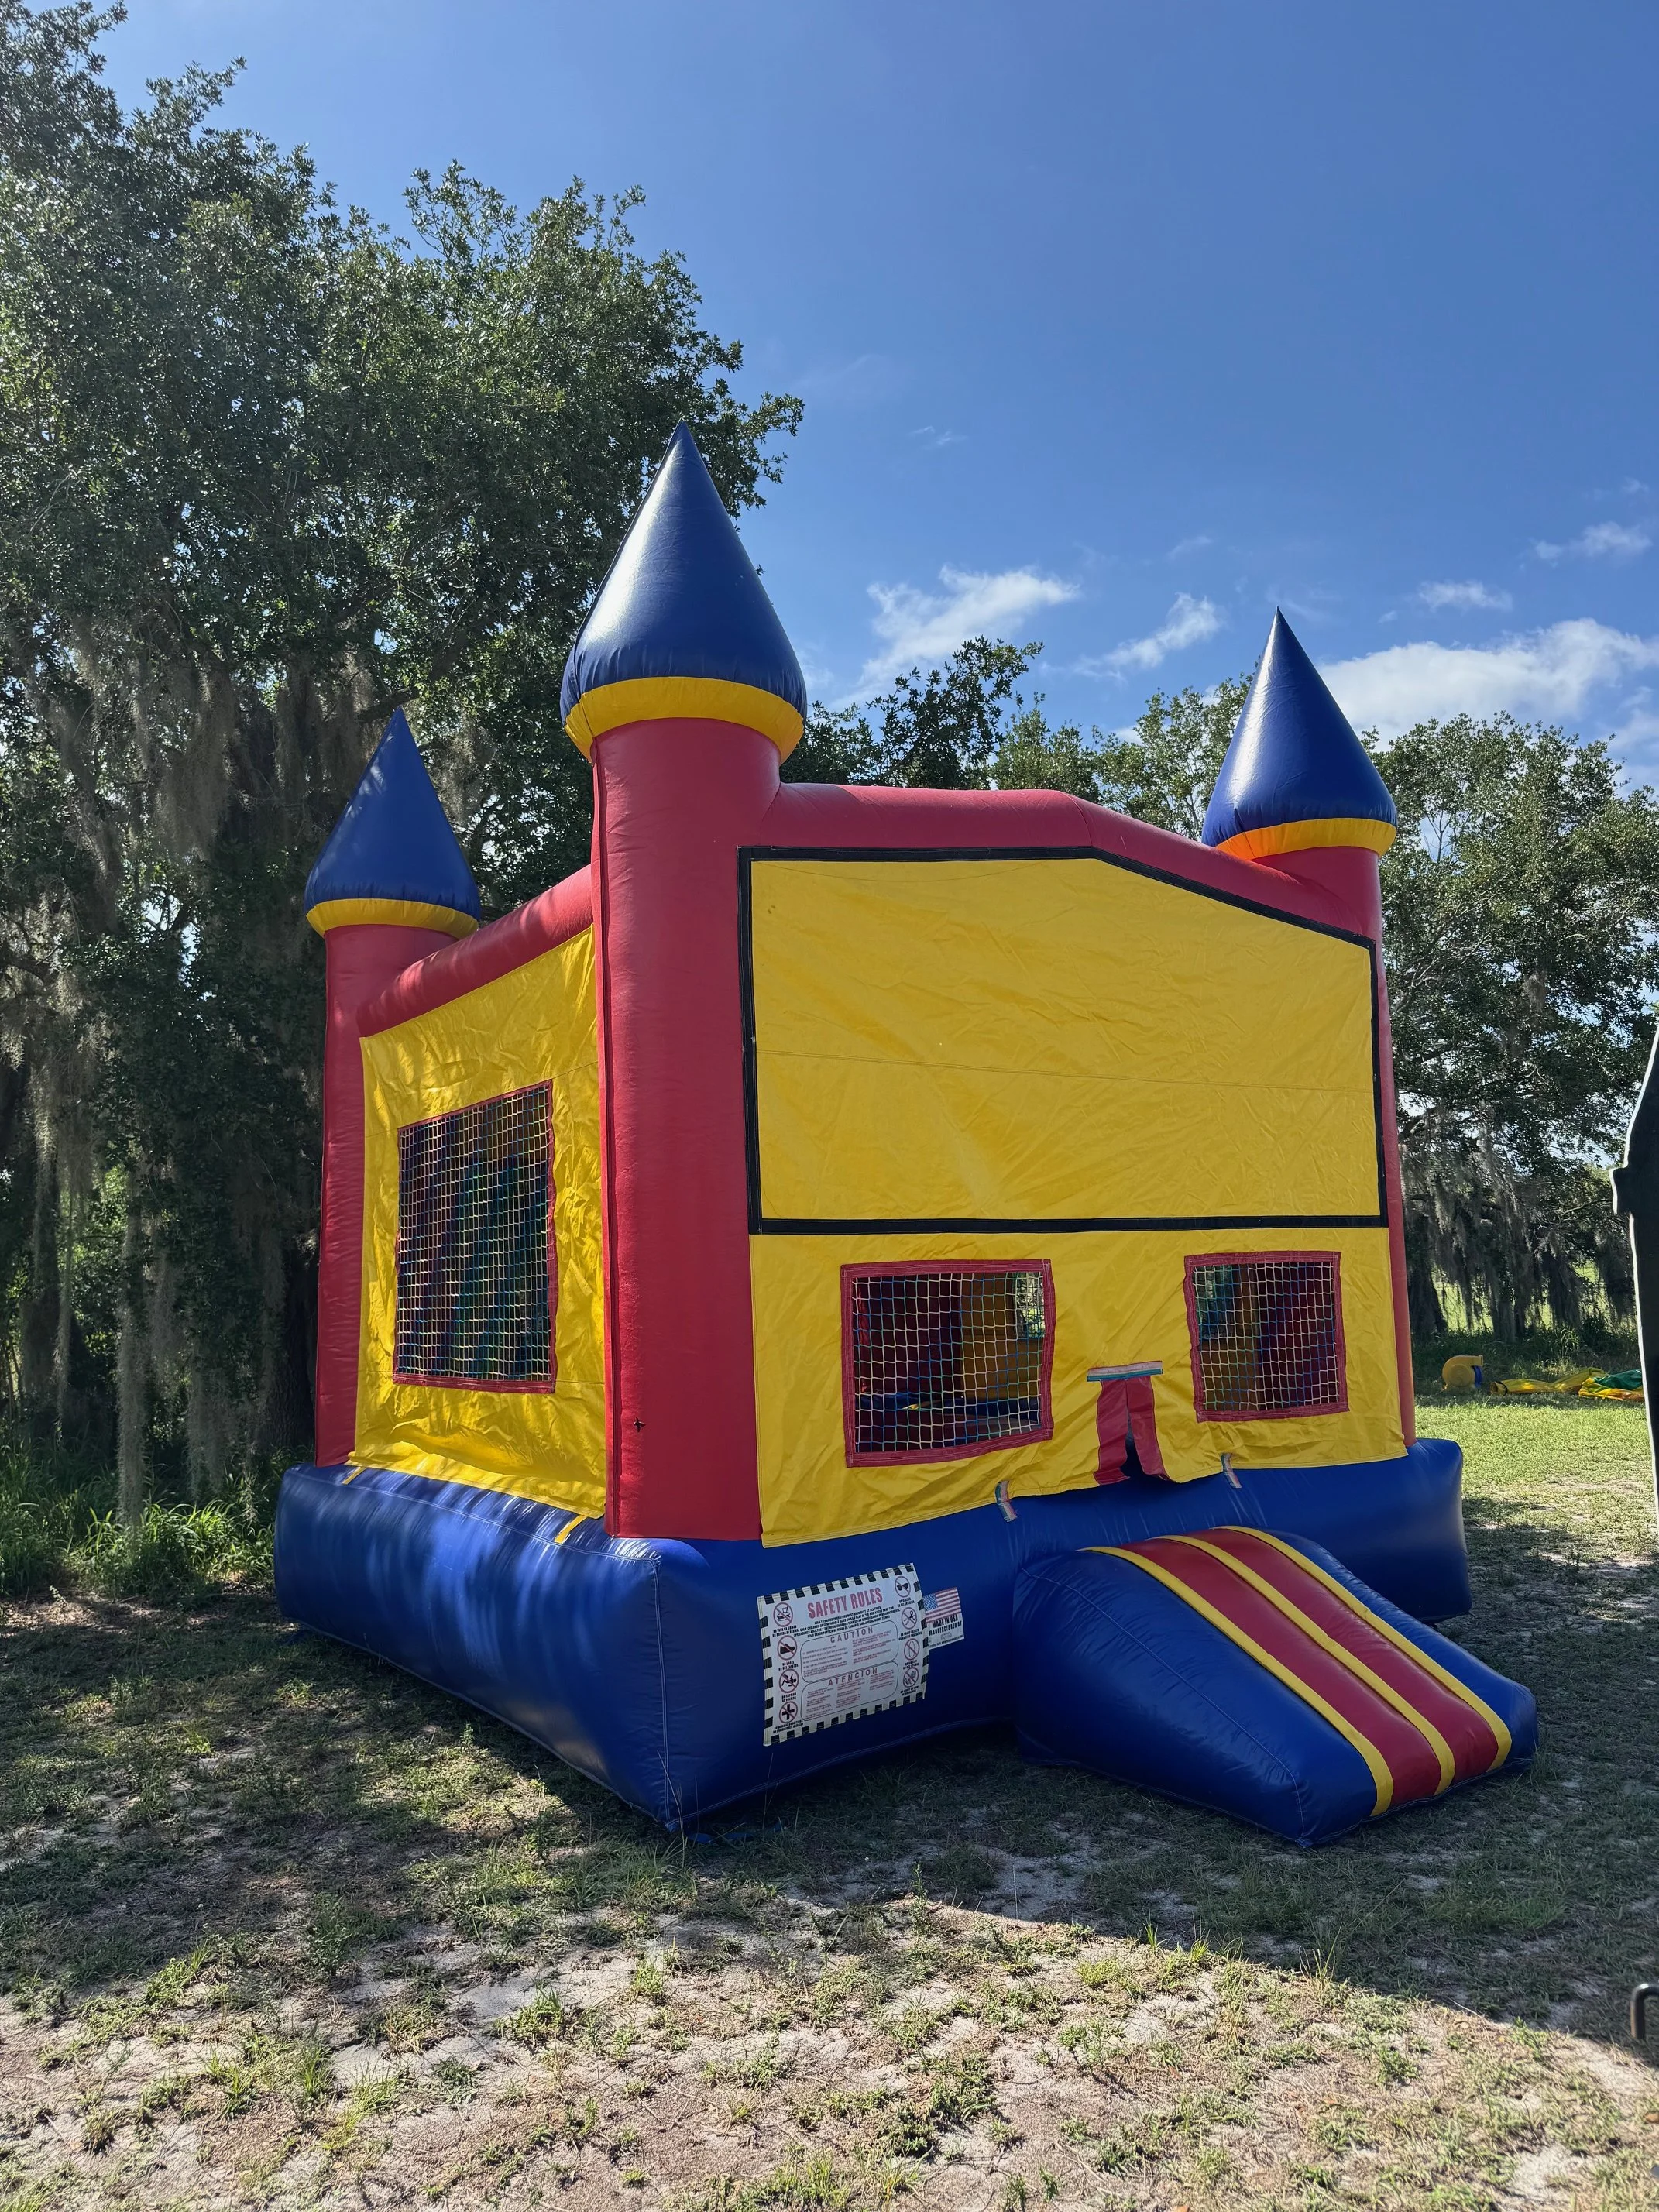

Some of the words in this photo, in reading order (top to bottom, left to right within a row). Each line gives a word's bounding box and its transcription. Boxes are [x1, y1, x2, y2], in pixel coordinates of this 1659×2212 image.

[807, 1595, 847, 1619] SAFETY
[850, 1587, 883, 1609] RULES
[932, 1617, 945, 1628] MADE
[944, 1616, 950, 1625] IN
[950, 1614, 959, 1623] USA
[830, 1627, 873, 1643] CAUTION
[828, 1668, 878, 1686] ATENCION
